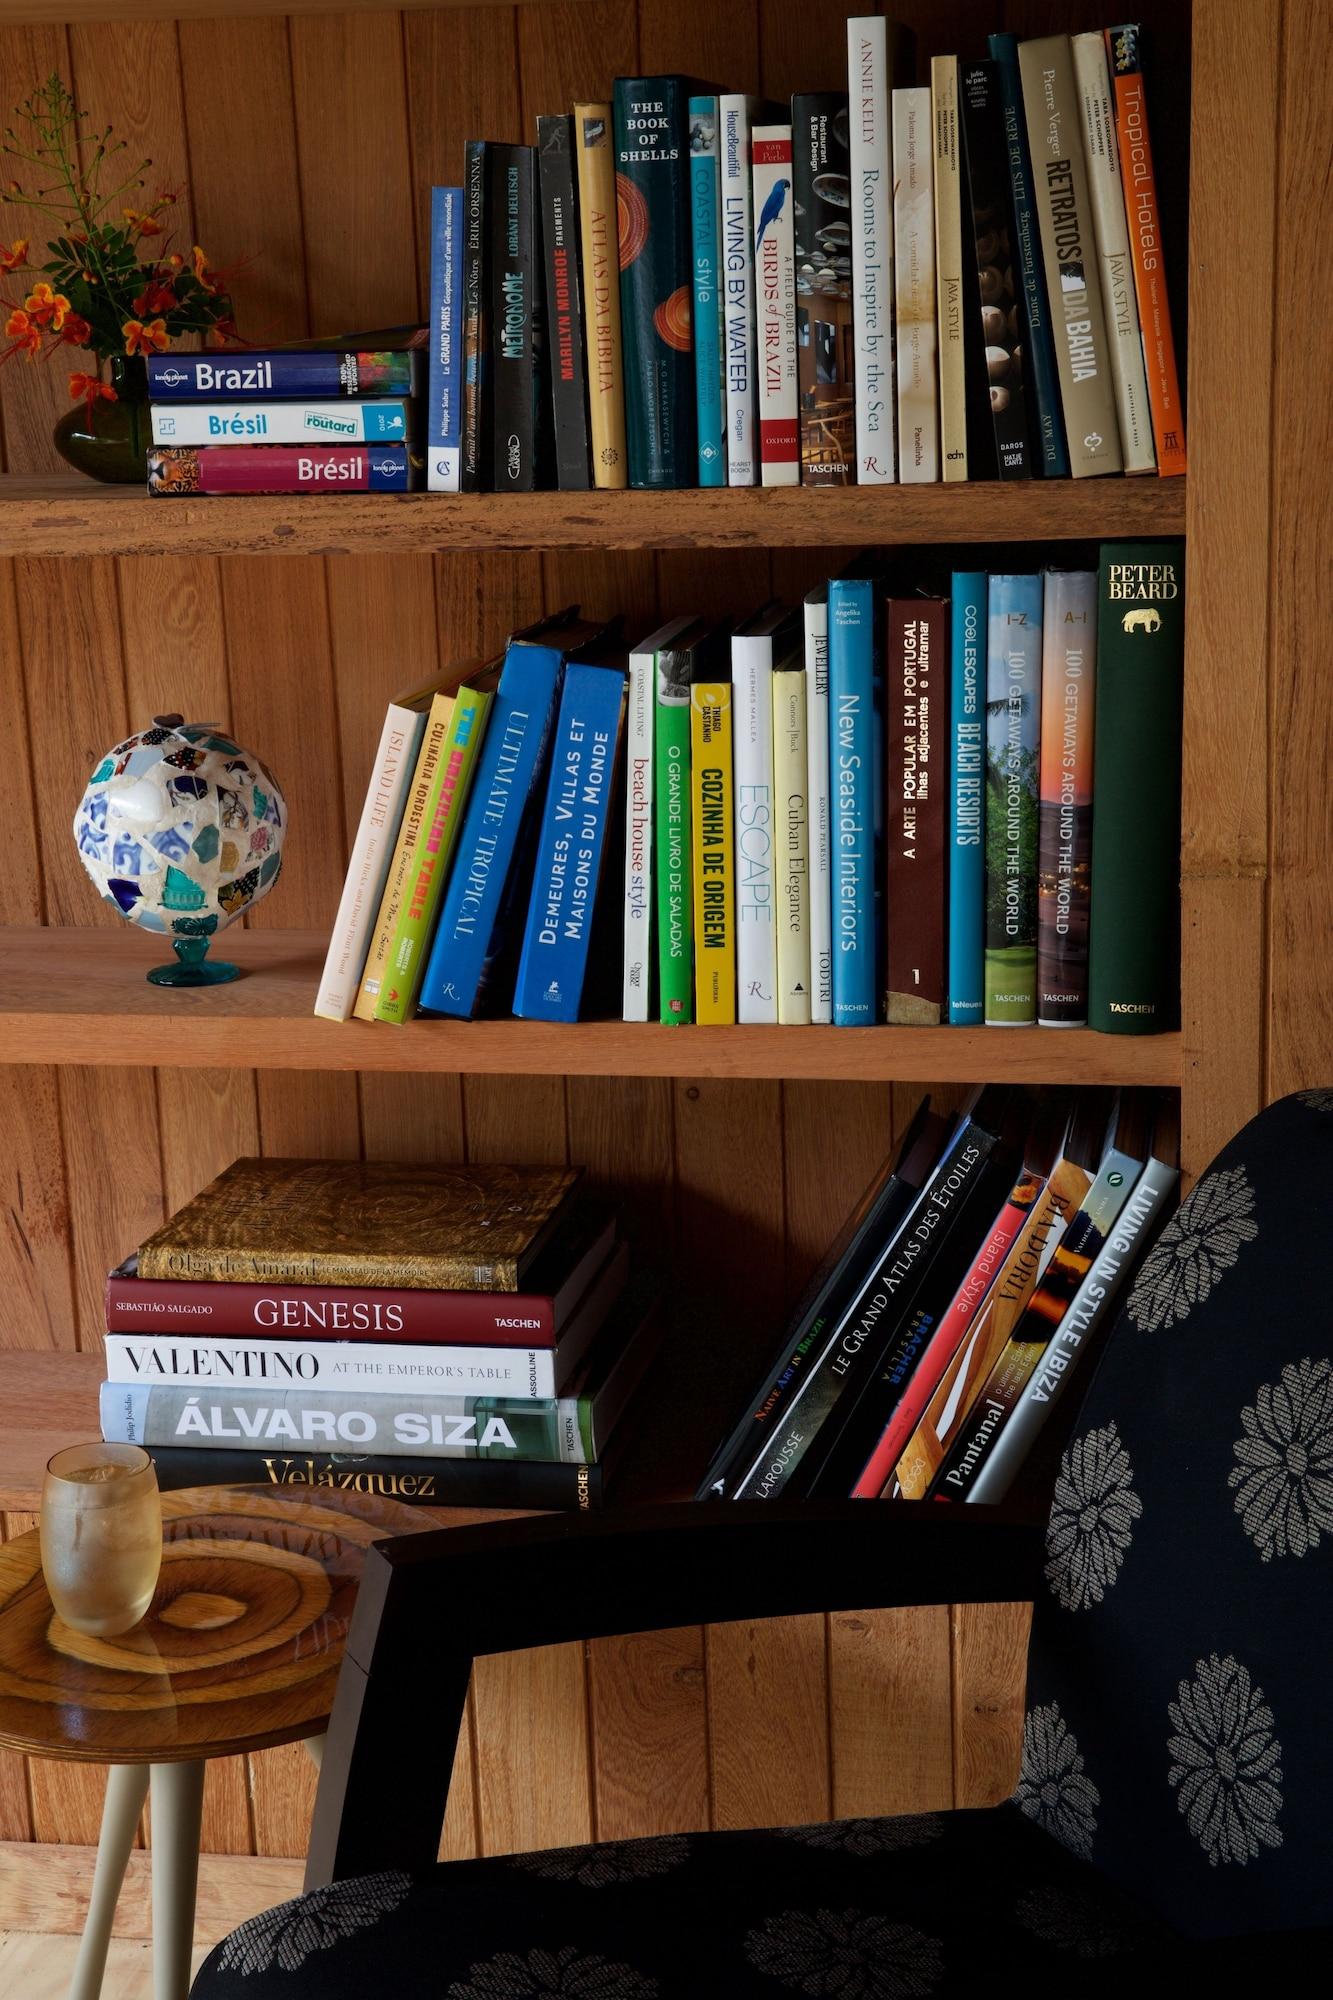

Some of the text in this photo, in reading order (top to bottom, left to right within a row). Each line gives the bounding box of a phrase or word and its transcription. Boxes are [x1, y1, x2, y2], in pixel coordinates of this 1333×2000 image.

[627, 118, 672, 130] BOOK
[631, 102, 664, 114] THE
[620, 148, 678, 162] SHELLS
[638, 134, 658, 145] OF
[810, 142, 819, 172] Design
[819, 116, 828, 164] Restaurant
[507, 167, 518, 214] DEUTSCH
[1124, 84, 1160, 305] Tropical Hotels Thailand
[444, 226, 452, 241] ville
[860, 38, 885, 432] ANNIE KELLY Rooms to Inspire by the Sea
[1043, 68, 1098, 383] Pierre Verger RETRATOS DA BAHIA
[444, 243, 452, 260] d'une
[468, 156, 481, 339] André Le ORSENNA
[592, 210, 610, 318] ATLAS DA
[443, 262, 453, 305] Géopolitique
[554, 198, 574, 380] MARILYN MONROE FRAGMENTS
[694, 258, 714, 303] style
[785, 268, 794, 298] FIELD
[441, 306, 451, 332] PARIS
[727, 198, 748, 442] LIVING BY WATER Cregan
[764, 239, 782, 397] BIRDS BRAZIL
[786, 303, 794, 336] GUIDE
[1009, 147, 1056, 460] DU MAY Diane DE
[440, 334, 450, 364] GRAND
[786, 340, 796, 352] TO
[196, 361, 272, 389] Brazil
[444, 366, 450, 375] Le
[787, 359, 796, 378] THE
[209, 412, 267, 434] Brésil
[308, 417, 355, 434] routard
[442, 409, 450, 437] Philippe
[298, 456, 363, 480] Brésil
[808, 463, 849, 473] TASCHEN
[914, 427, 923, 466] Panelinha
[1109, 564, 1176, 582] PETER
[1109, 582, 1178, 600] BEARD
[636, 668, 645, 704] COASTAL
[917, 620, 930, 762] adjacentes e ultramar
[702, 706, 712, 742] CASTANHO
[712, 706, 722, 732] THIAGO
[903, 620, 917, 860] A ARTE POPULAR EM PORTUGAL
[790, 733, 798, 752] Buck
[370, 730, 406, 828] ISLAND LIFE
[555, 718, 586, 820] VILLAS ET
[956, 722, 982, 846] BEACH RESORTS
[740, 668, 771, 922] HERMES MALLEA ESCAPE
[1006, 650, 1026, 935] 100 GETAWAYS AROUND THE WORLD
[1056, 648, 1084, 934] 100 GETAWAYS AROUND THE WORLD
[404, 783, 430, 848] NORDESTINA
[453, 710, 529, 940] ULTIMATE TROPICAL
[564, 732, 609, 939] MAISONS DU MONDE
[838, 694, 864, 952] New Seaside Interiors
[628, 758, 650, 920] beach house style
[668, 762, 682, 958] GRANDE LIVRO DE SALADAS
[702, 768, 726, 948] COZINHA DE ORIGEM
[786, 794, 806, 932] Cuban Elegance
[820, 949, 830, 1003] TODTRI
[912, 968, 920, 984] 1
[1042, 993, 1079, 1001] TASCHEN
[836, 1004, 869, 1012] TASCHEN
[995, 994, 1031, 1002] TASCHEN
[1109, 1002, 1156, 1014] TASCHEN
[1110, 1184, 1160, 1254] LIVING
[168, 1254, 213, 1276] Olga
[976, 1229, 1012, 1275] Island
[1094, 1259, 1121, 1282] IN
[116, 1298, 541, 1331] SEBASTIÃO SALGADO GENESIS TASCHEN
[755, 1144, 980, 1499] LAROUSSE GRAND ATLAS DES ÉTOILES
[1062, 1282, 1107, 1348] STYLE
[122, 1346, 512, 1380] VALENTINO AT THE TABLE
[528, 1352, 536, 1398] ASSOULINE
[1029, 1348, 1072, 1404] IBIZA
[124, 1394, 133, 1422] Jodidio
[174, 1397, 518, 1449] ÁLVARO SIZA
[944, 1398, 1006, 1487] Pantanal
